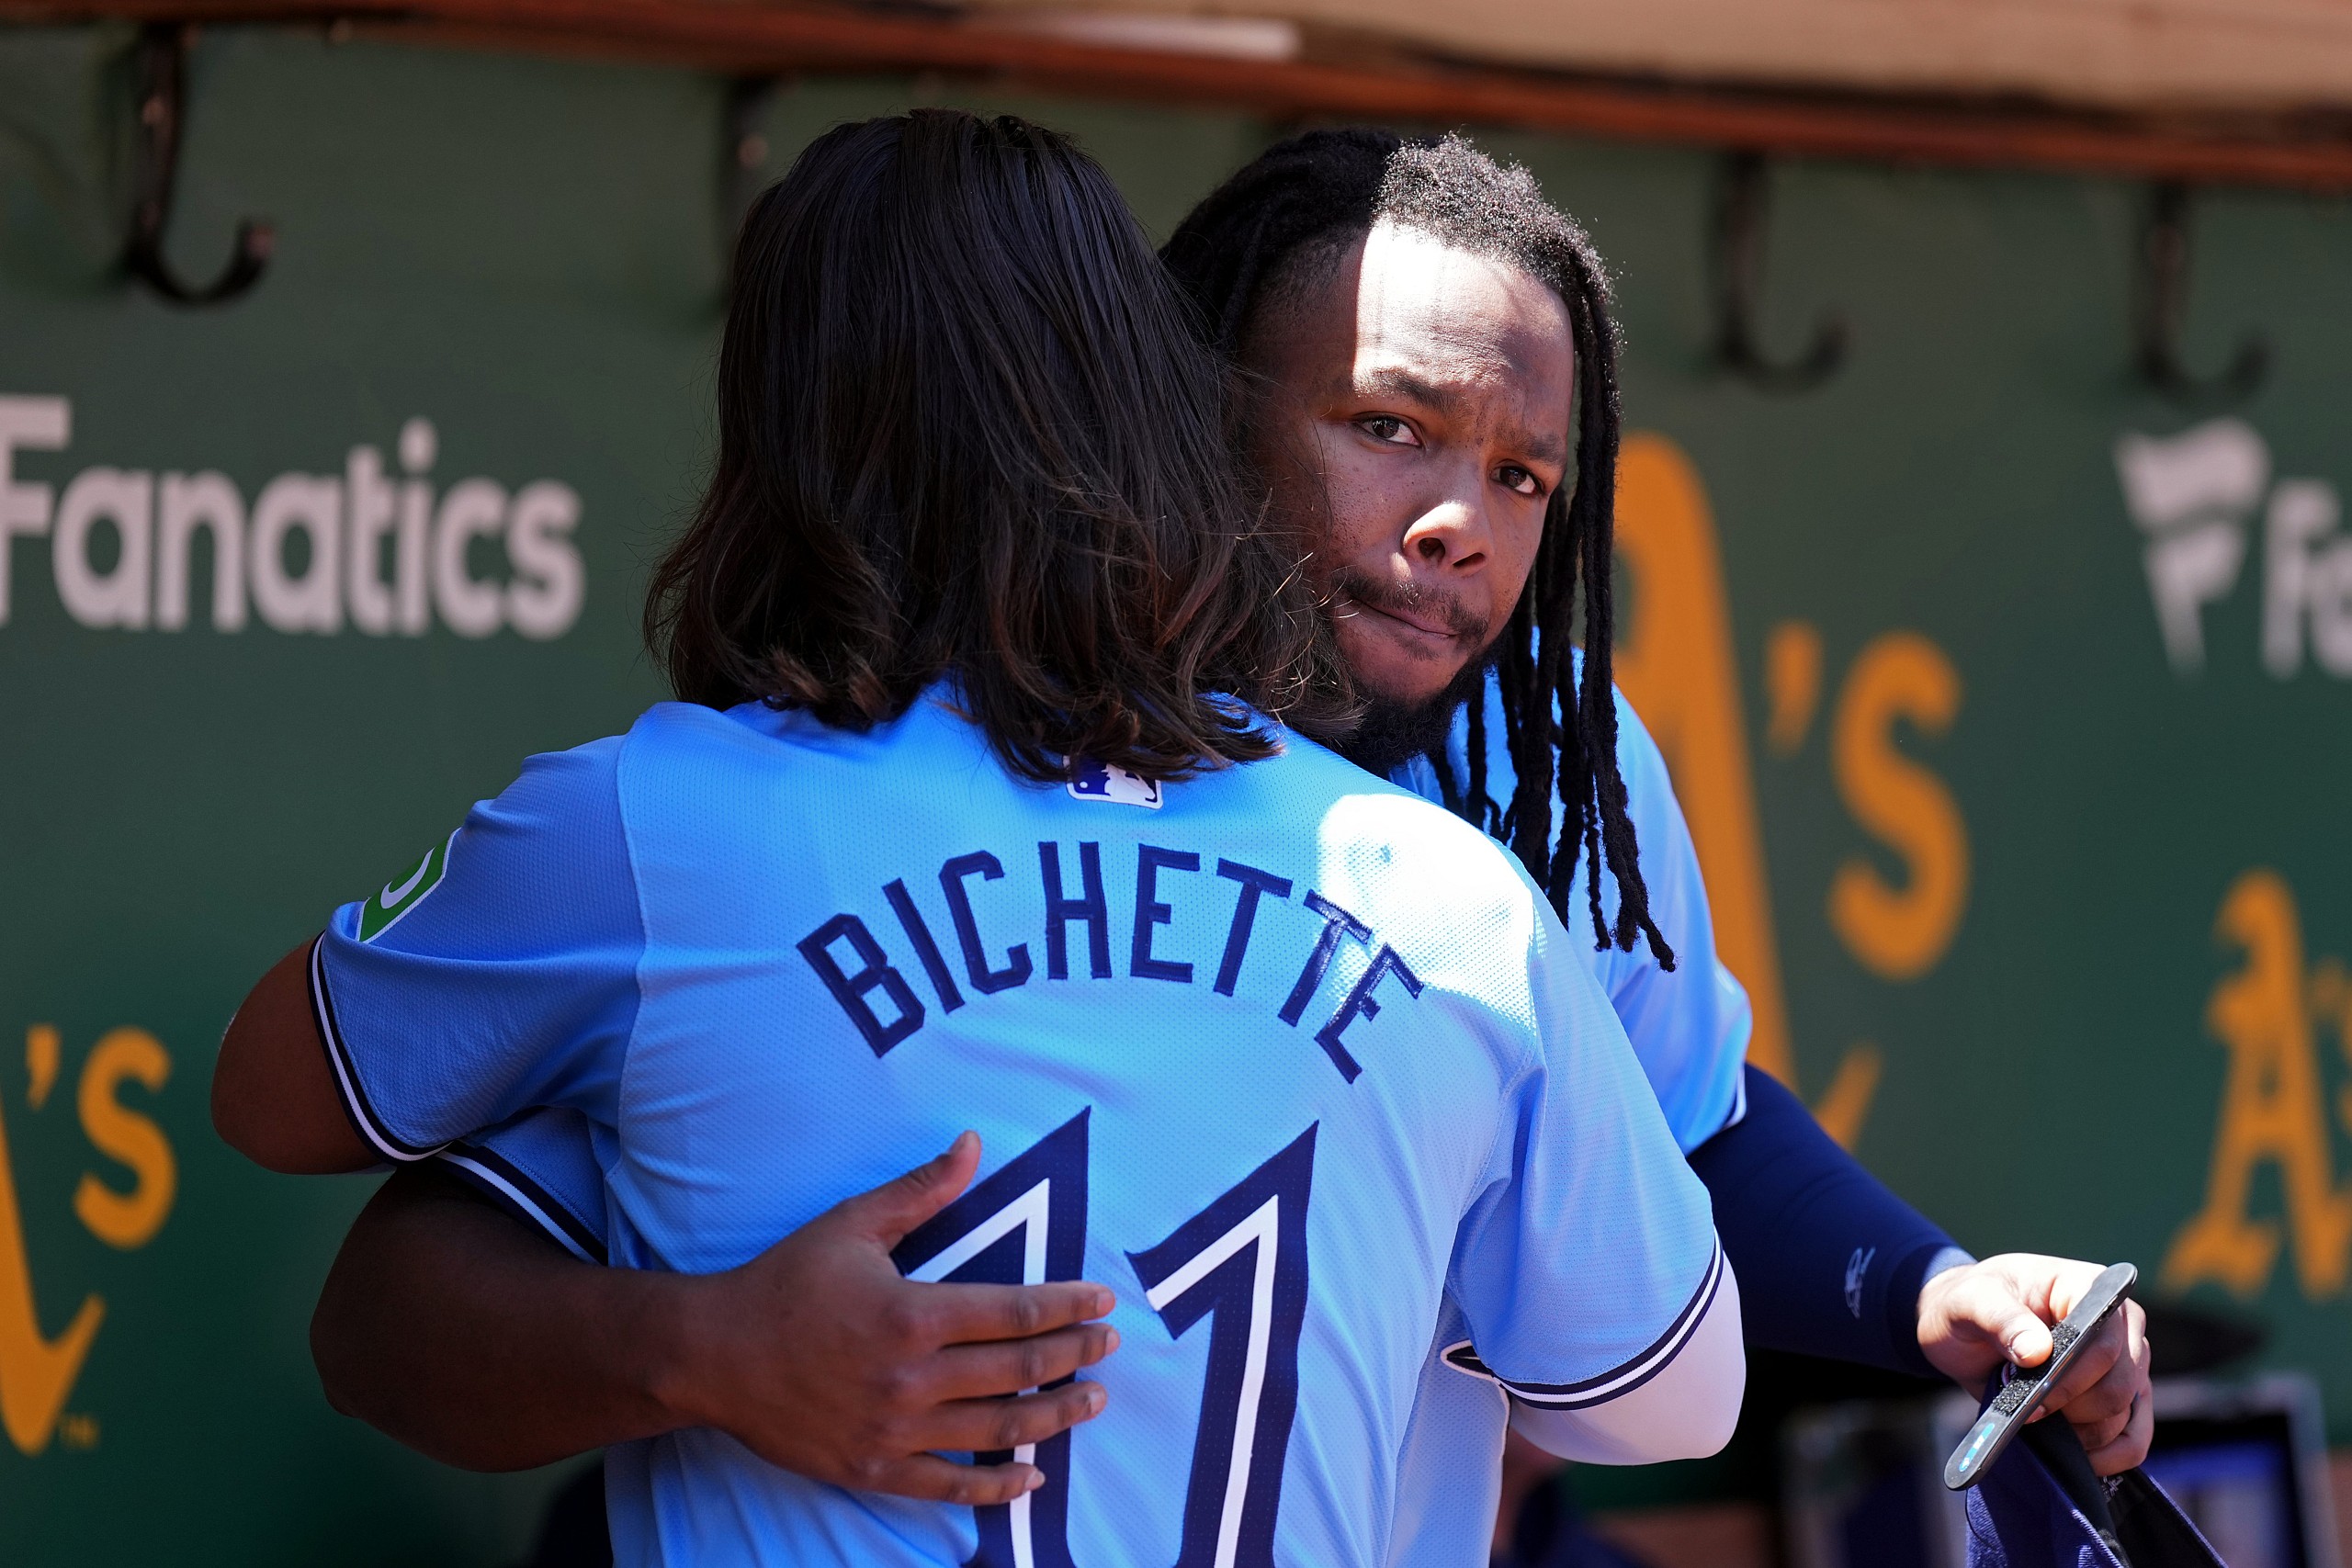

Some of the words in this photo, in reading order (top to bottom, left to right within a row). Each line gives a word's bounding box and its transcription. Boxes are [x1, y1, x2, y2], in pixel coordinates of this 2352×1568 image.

[0, 395, 585, 638] Fanatics
[796, 841, 1424, 1086] BICHETTE
[888, 1104, 1320, 1568] 11
